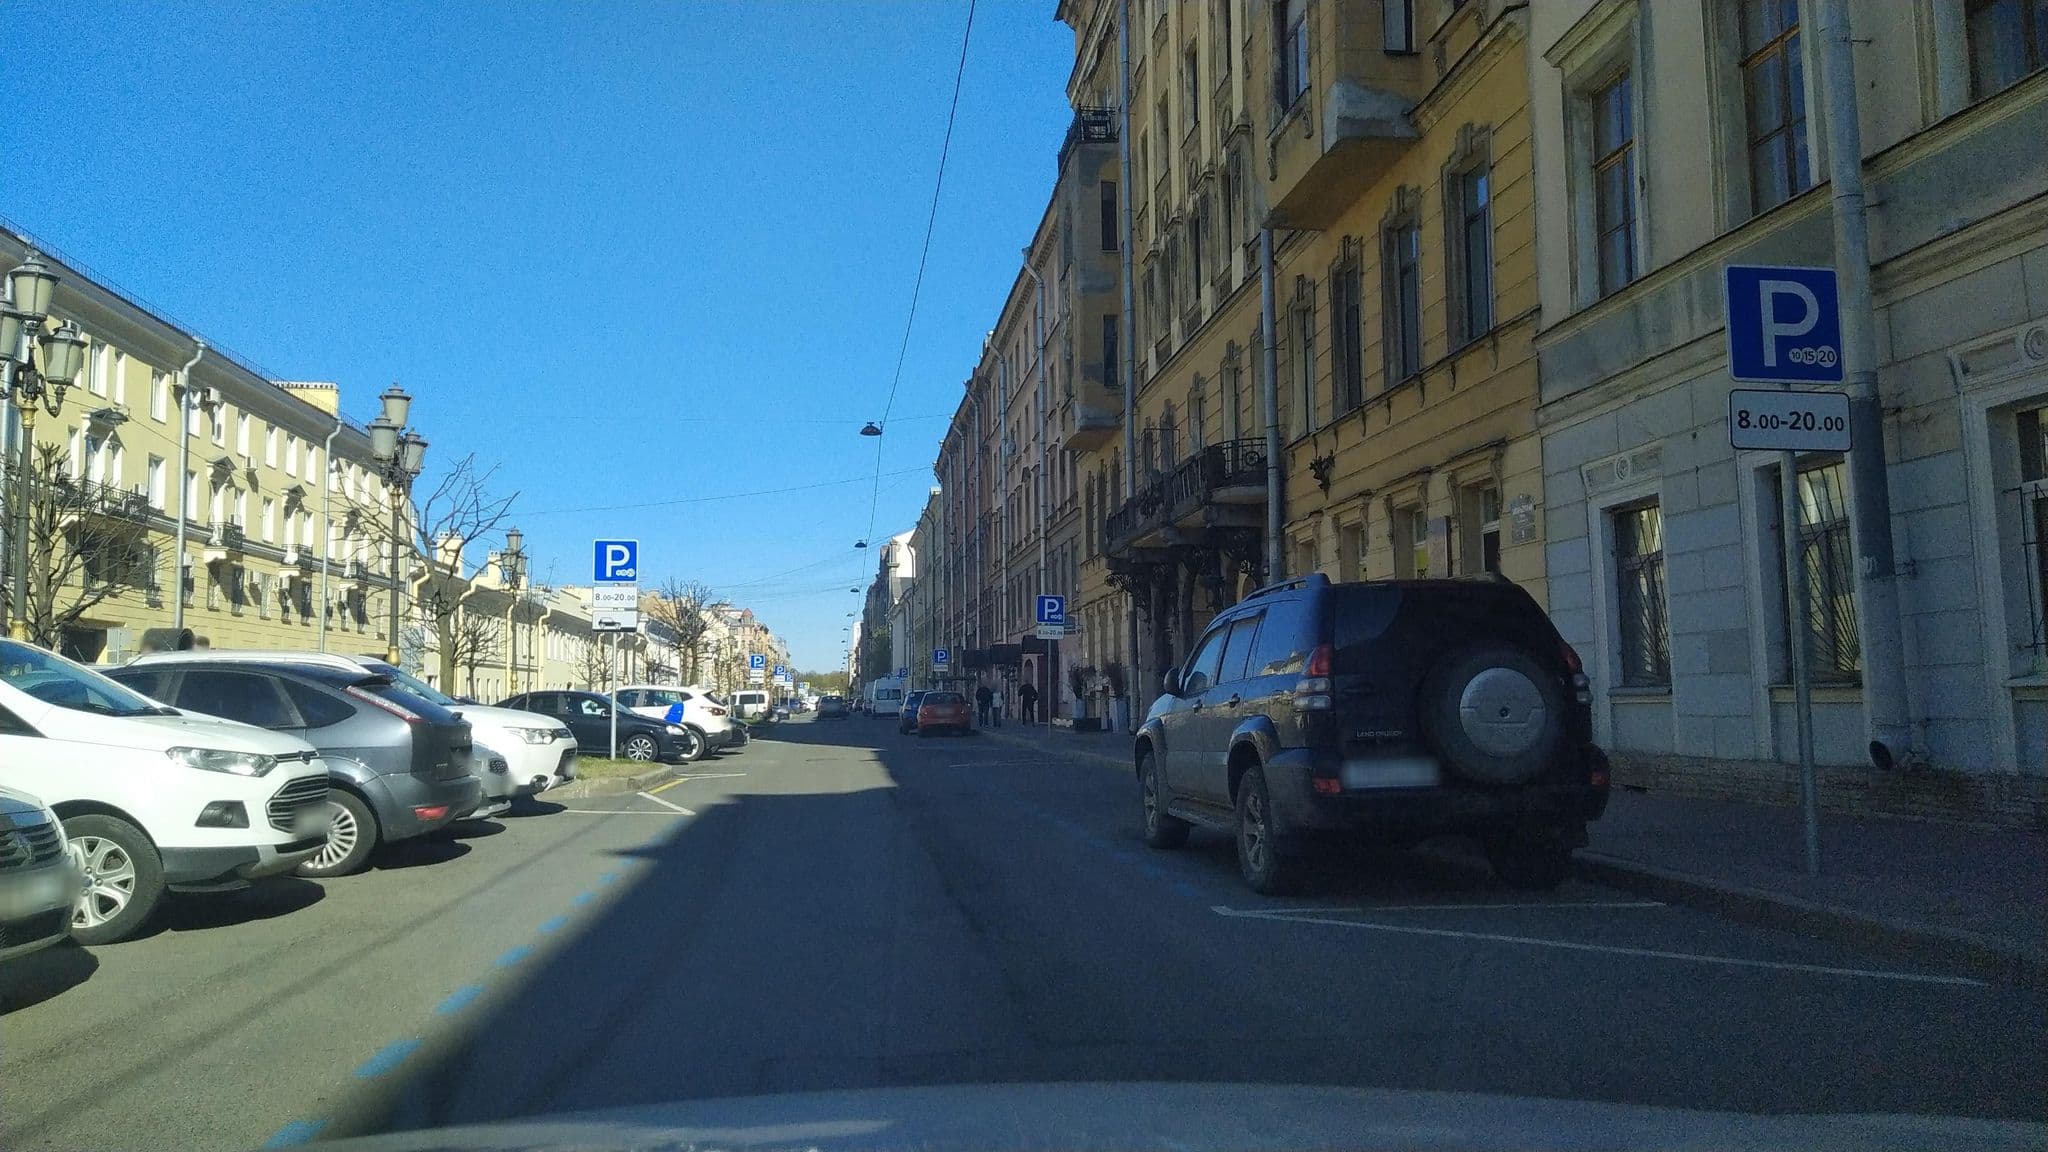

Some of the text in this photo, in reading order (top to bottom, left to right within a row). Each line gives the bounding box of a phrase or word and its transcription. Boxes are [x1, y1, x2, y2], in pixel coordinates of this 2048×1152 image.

[1760, 280, 1820, 367] P
[1819, 350, 1835, 363] 20
[1737, 409, 1844, 432] 8.00-20.00
[606, 544, 630, 578] P
[1044, 598, 1060, 620] P
[753, 656, 763, 668] P
[937, 651, 946, 662] P
